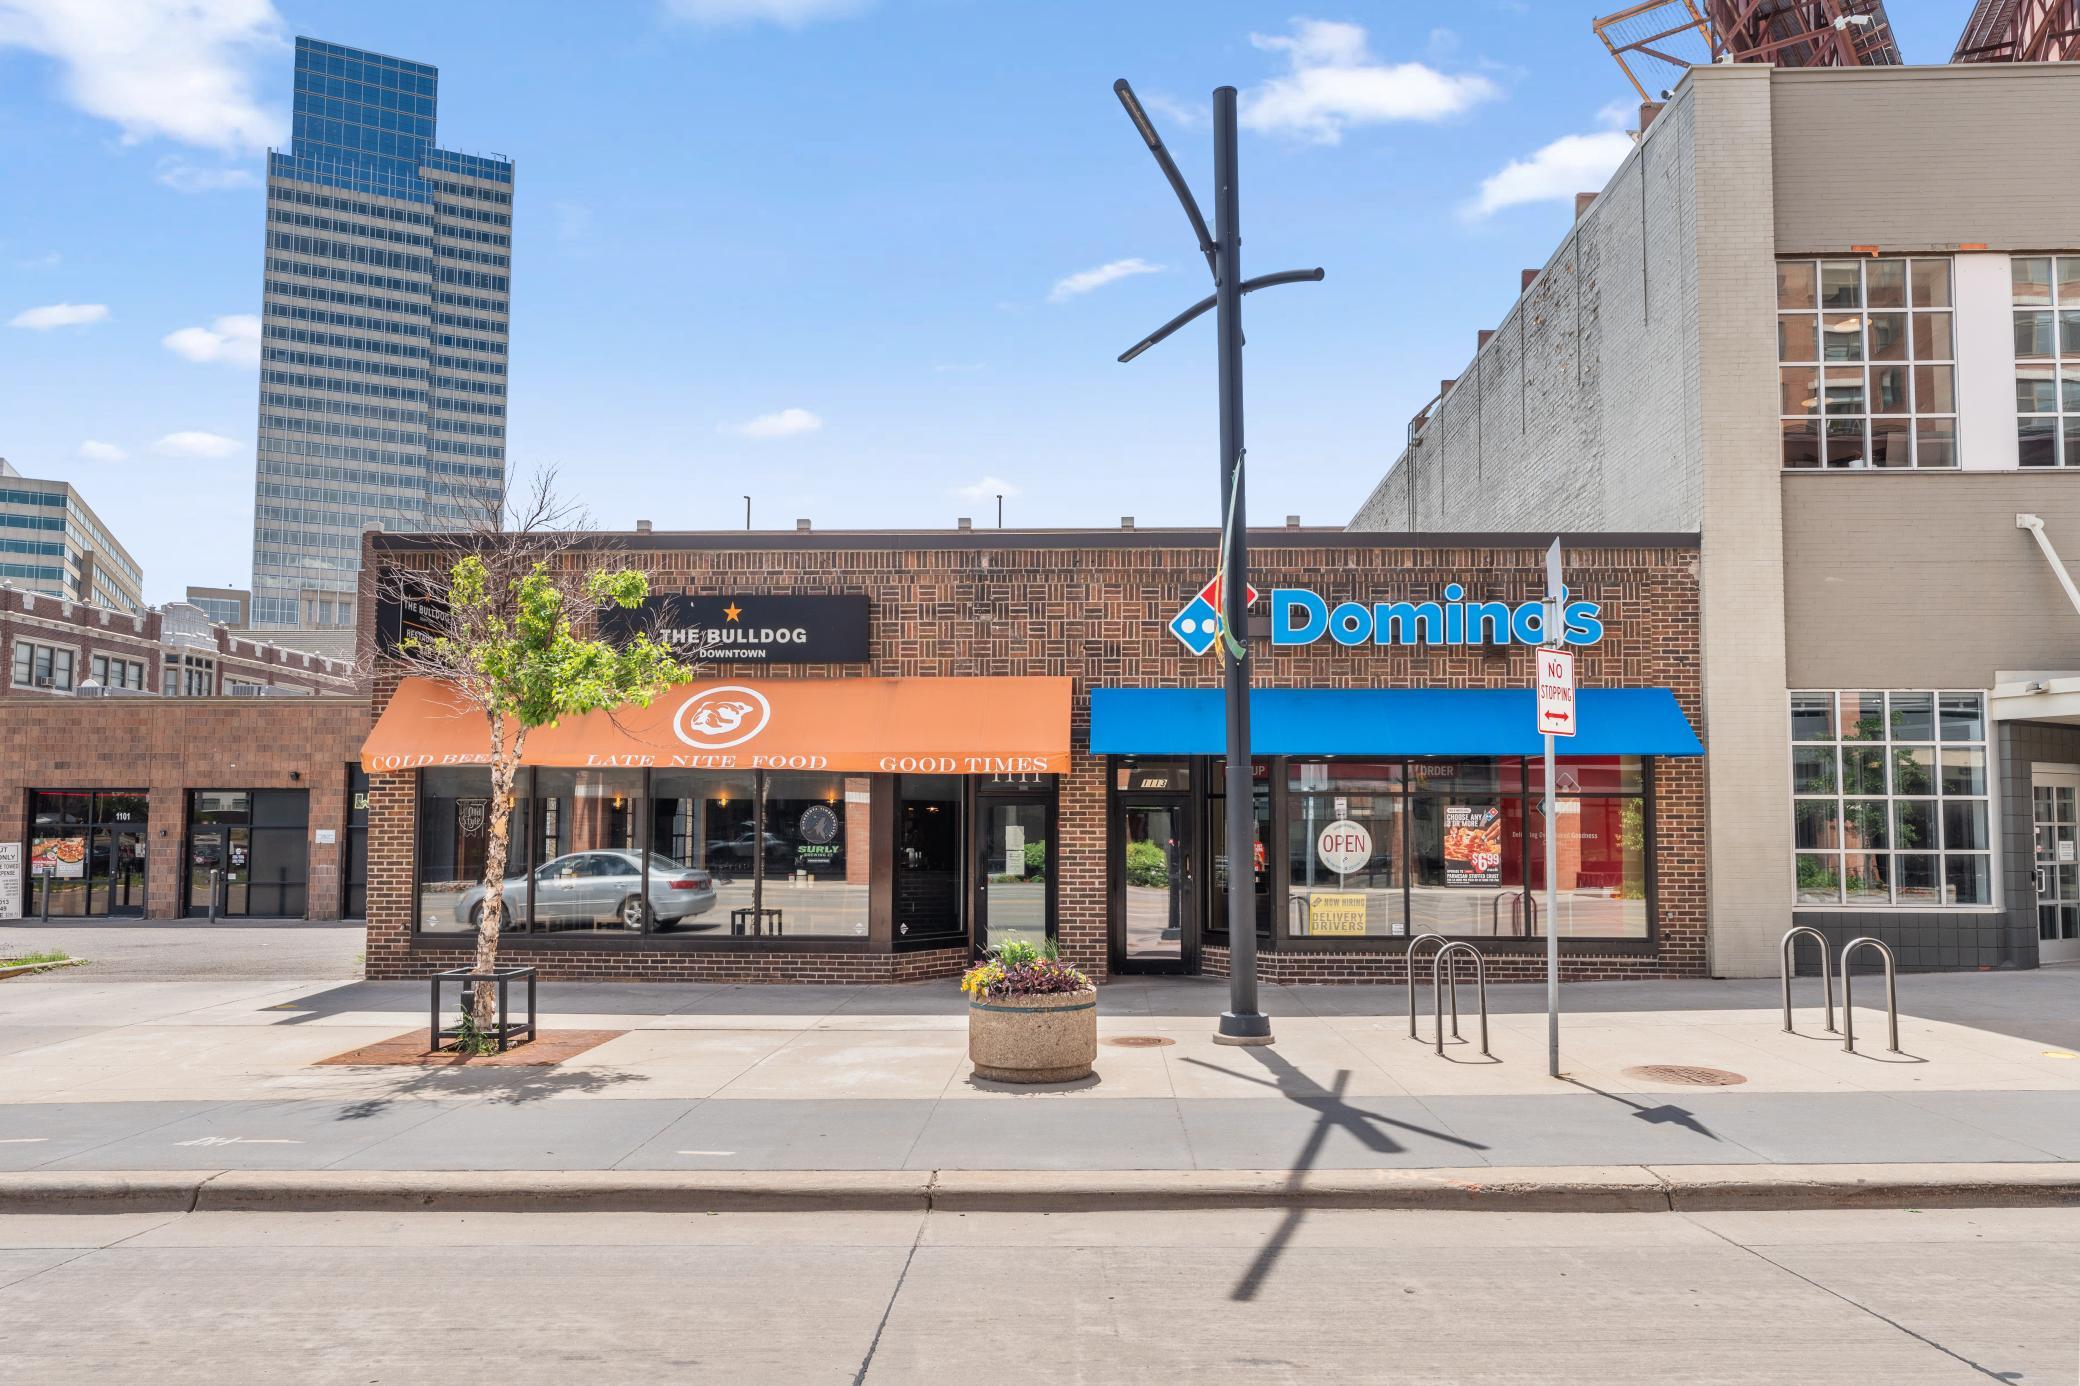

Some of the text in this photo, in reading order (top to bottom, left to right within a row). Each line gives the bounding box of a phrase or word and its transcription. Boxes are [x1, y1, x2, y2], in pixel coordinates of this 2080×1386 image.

[659, 628, 807, 644] THE BULLDOG
[699, 650, 766, 658] DOWNTOWN
[1548, 662, 1563, 679] NO
[1541, 685, 1572, 702] STOPPING
[372, 753, 498, 771] COLD BEE
[587, 754, 828, 769] LATE NITE FOOD
[879, 756, 1048, 772] GOOD TIMES
[115, 812, 131, 821] 1101
[1446, 813, 1483, 821] CHOOSE ANY
[798, 845, 839, 853] SURLY
[1323, 834, 1365, 853] OPEN
[1324, 898, 1365, 907] NOW HIRING
[1312, 912, 1364, 922] DELIVERY
[1312, 921, 1364, 931] DRIVERS
